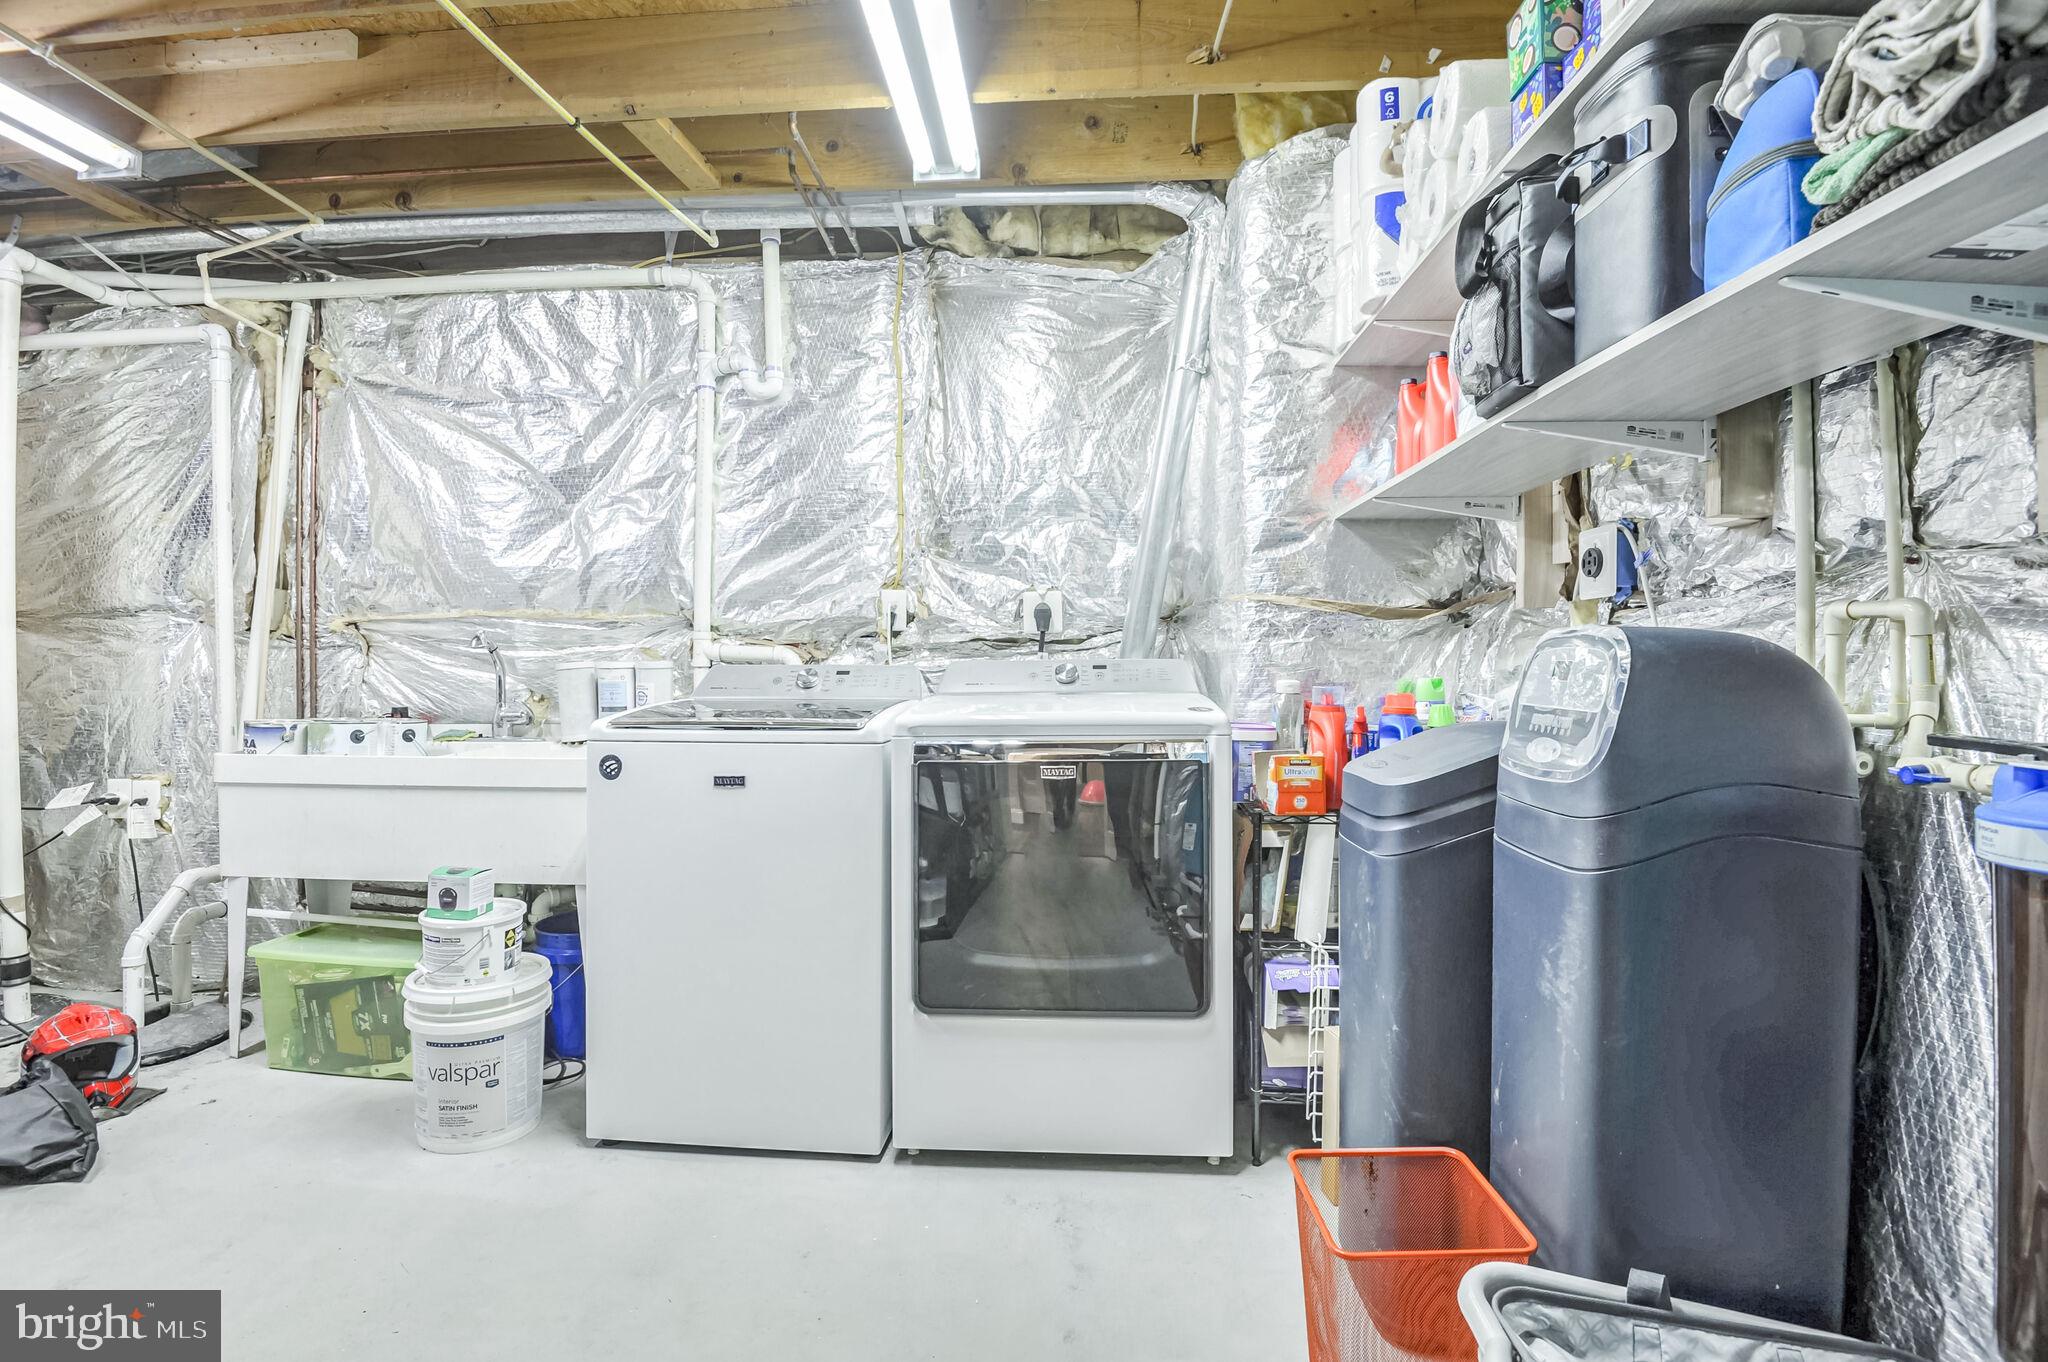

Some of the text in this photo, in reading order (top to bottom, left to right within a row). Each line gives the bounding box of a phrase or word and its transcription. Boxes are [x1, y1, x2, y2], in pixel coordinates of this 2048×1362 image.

[1384, 91, 1395, 103] 6
[1042, 768, 1074, 776] MAYTAG
[1284, 767, 1317, 776] UltraSoft
[428, 1062, 501, 1086] valspar
[456, 1103, 478, 1111] FINISH
